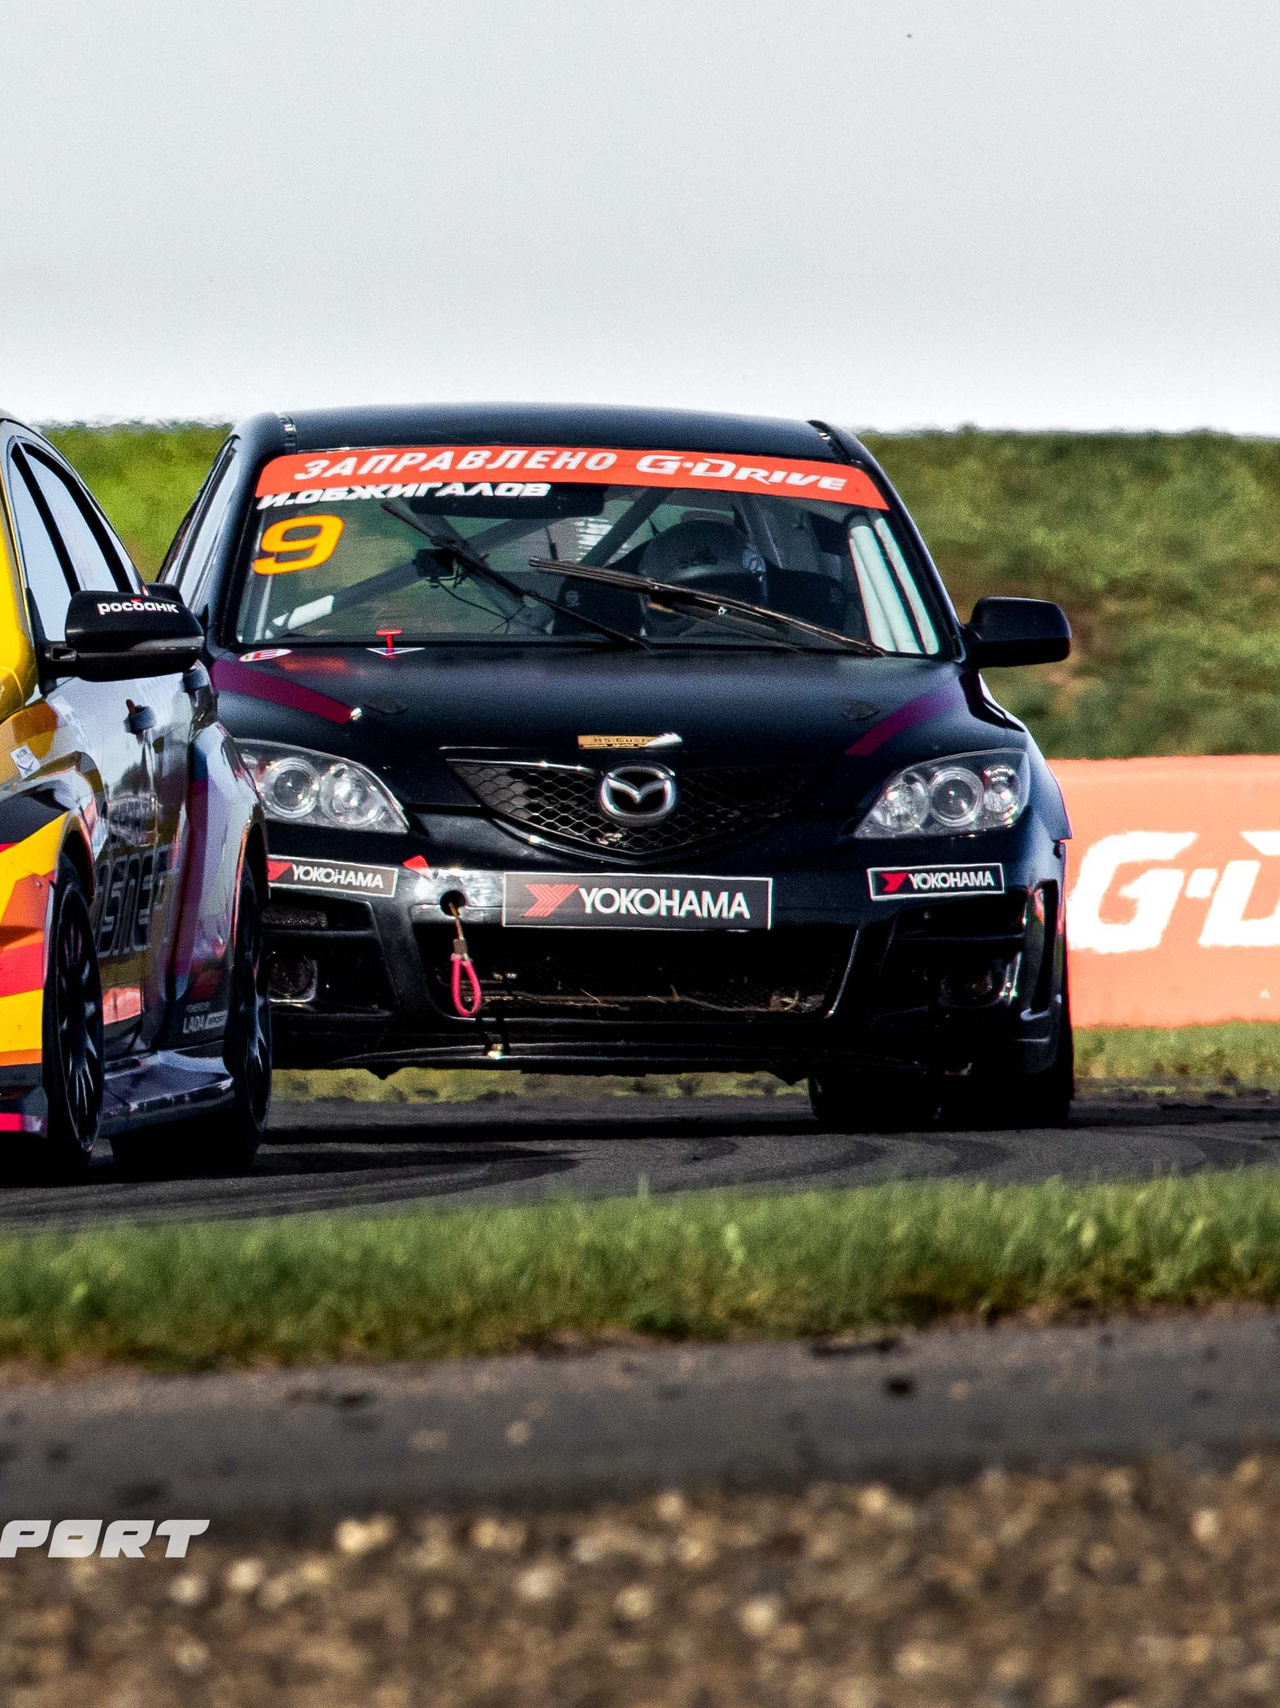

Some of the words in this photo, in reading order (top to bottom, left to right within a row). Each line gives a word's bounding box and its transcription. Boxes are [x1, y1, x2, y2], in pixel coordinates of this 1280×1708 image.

[294, 450, 618, 480] ЗАПРАВЛЕНО
[253, 514, 344, 576] 9
[97, 599, 180, 616] росбанк
[291, 864, 384, 889] YOKOHAMA
[908, 870, 995, 890] YOKOHAMA
[579, 888, 750, 919] YOKOHAMA
